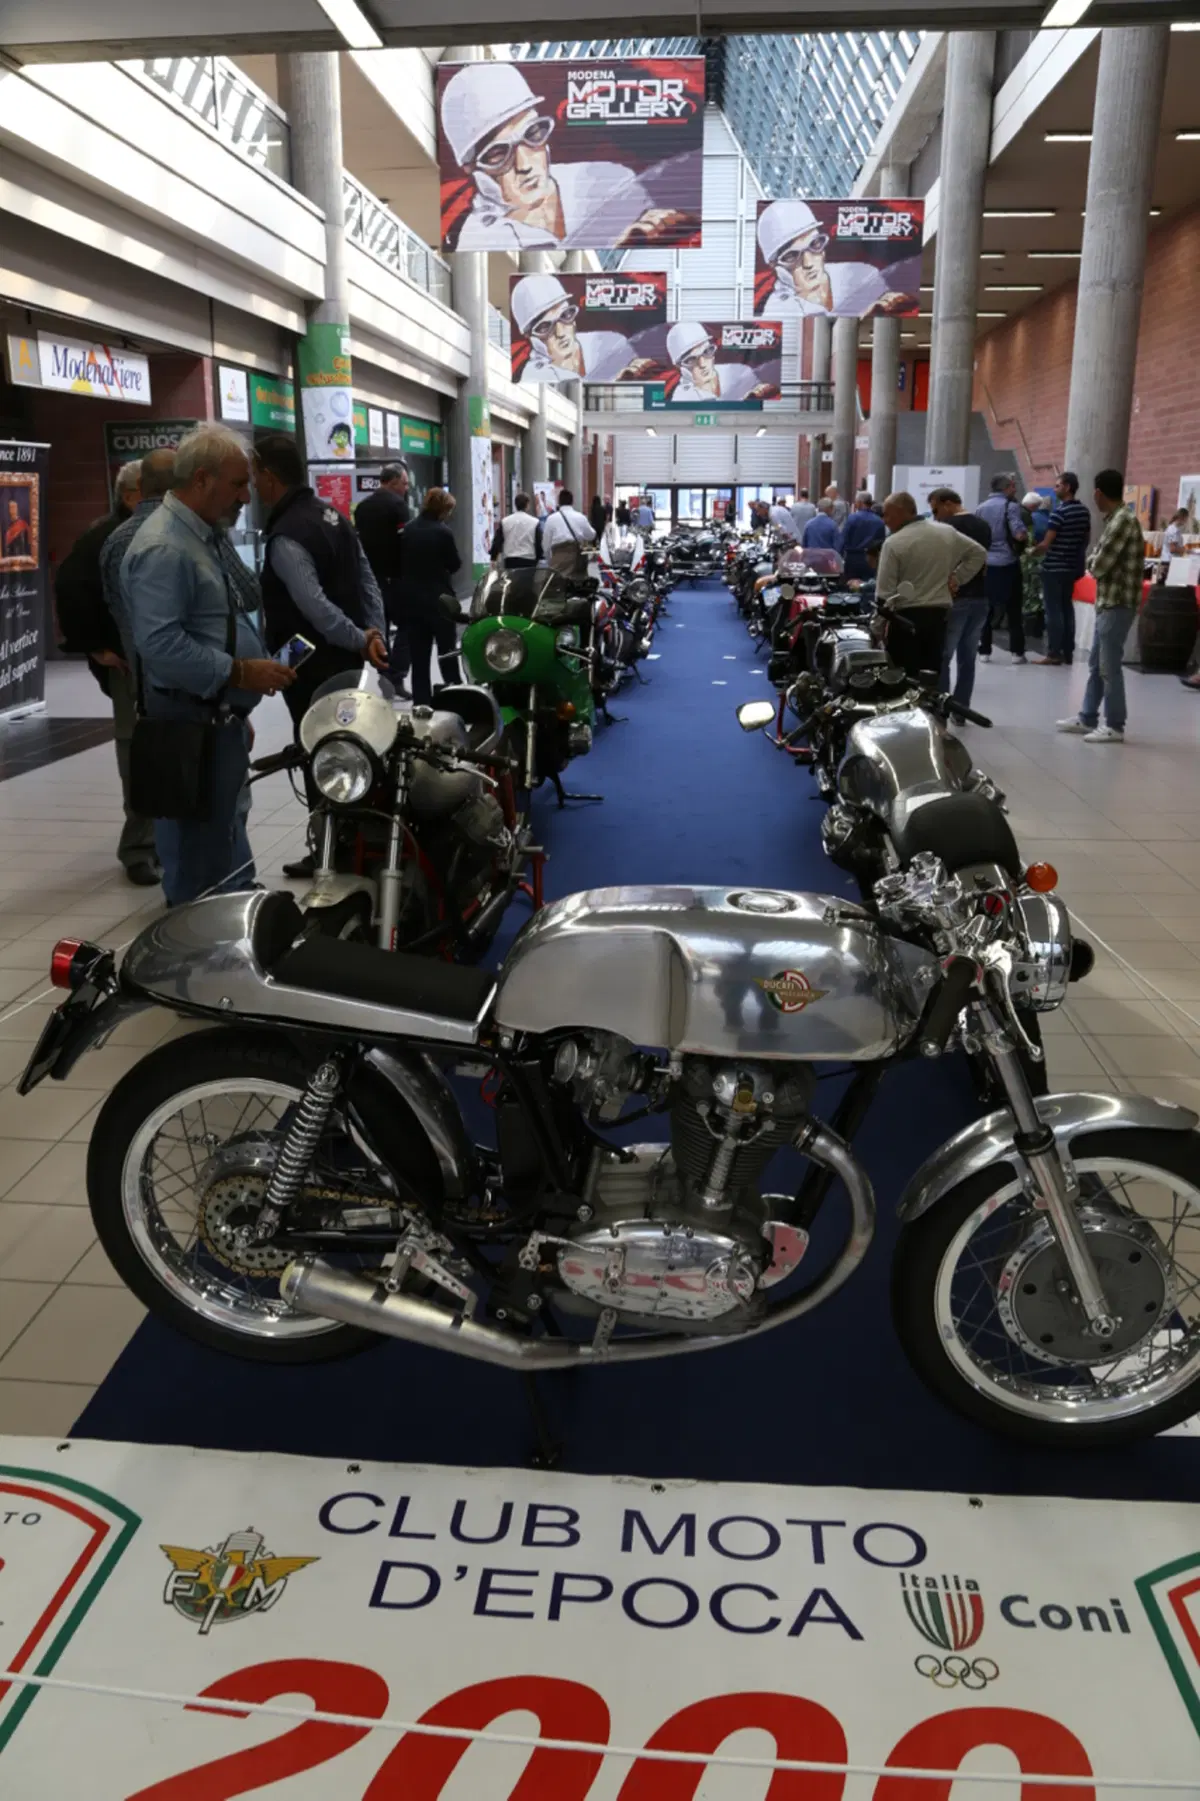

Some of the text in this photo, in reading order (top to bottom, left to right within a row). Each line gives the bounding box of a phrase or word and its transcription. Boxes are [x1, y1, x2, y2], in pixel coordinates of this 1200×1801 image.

[567, 70, 616, 80] MODENA
[568, 79, 684, 103] MOTOR
[566, 101, 688, 119] GALLERY
[838, 212, 911, 227] MOTOR
[837, 225, 913, 236] GALLERY
[586, 284, 655, 298] MOTOR
[585, 297, 656, 307] GALLERY
[722, 329, 774, 339] MOTOR
[52, 344, 142, 391] ModenaFiere
[16, 447, 37, 463] 1891
[763, 980, 795, 990] DUCATI
[318, 1491, 928, 1568] CLUB MOTO
[900, 1572, 981, 1592] Italia
[368, 1560, 865, 1642] D'EPOCA
[999, 1594, 1132, 1634] Coni
